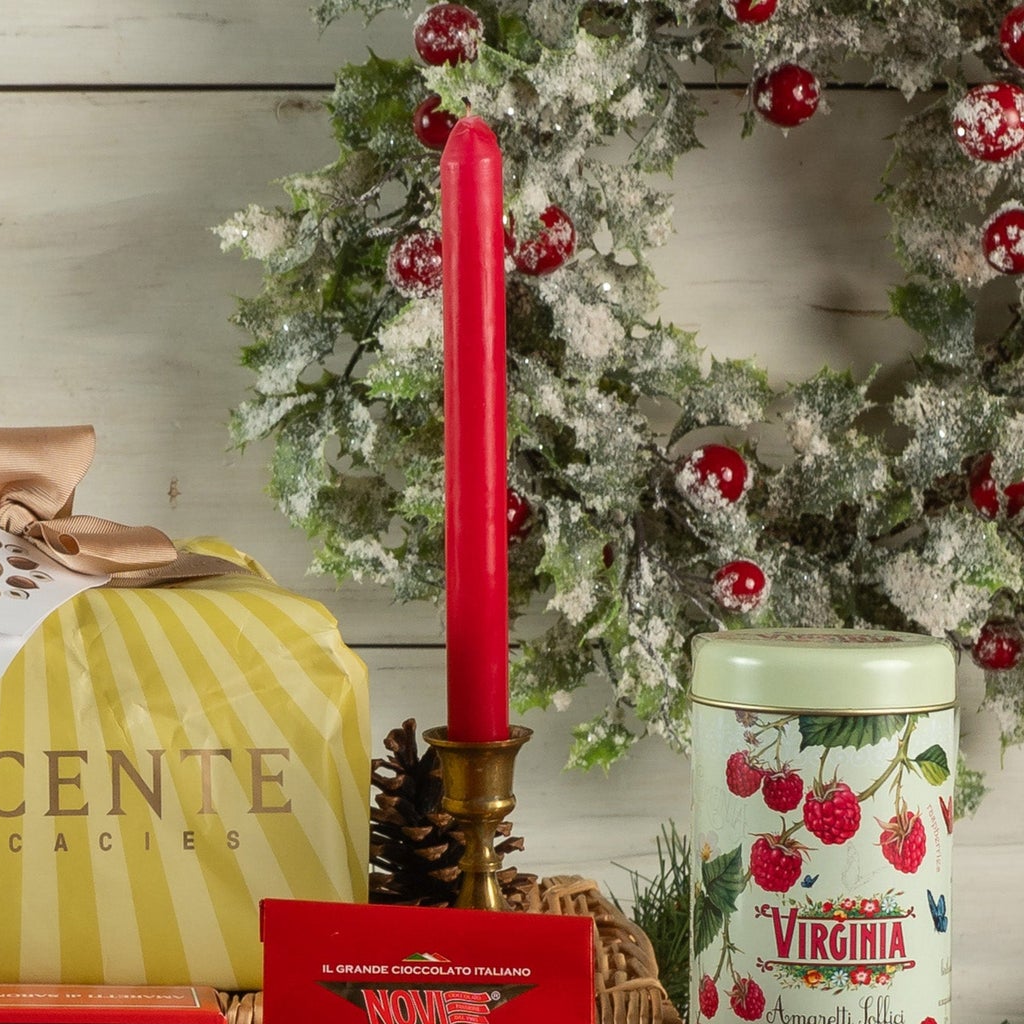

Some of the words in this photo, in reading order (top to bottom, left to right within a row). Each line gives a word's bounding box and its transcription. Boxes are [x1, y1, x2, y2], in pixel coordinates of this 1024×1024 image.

[771, 906, 907, 961] VIRGINIA
[322, 964, 334, 974] IL
[336, 964, 388, 975] GRANDE
[391, 965, 472, 976] CIOCCOLATO
[474, 966, 531, 977] ITALIANO
